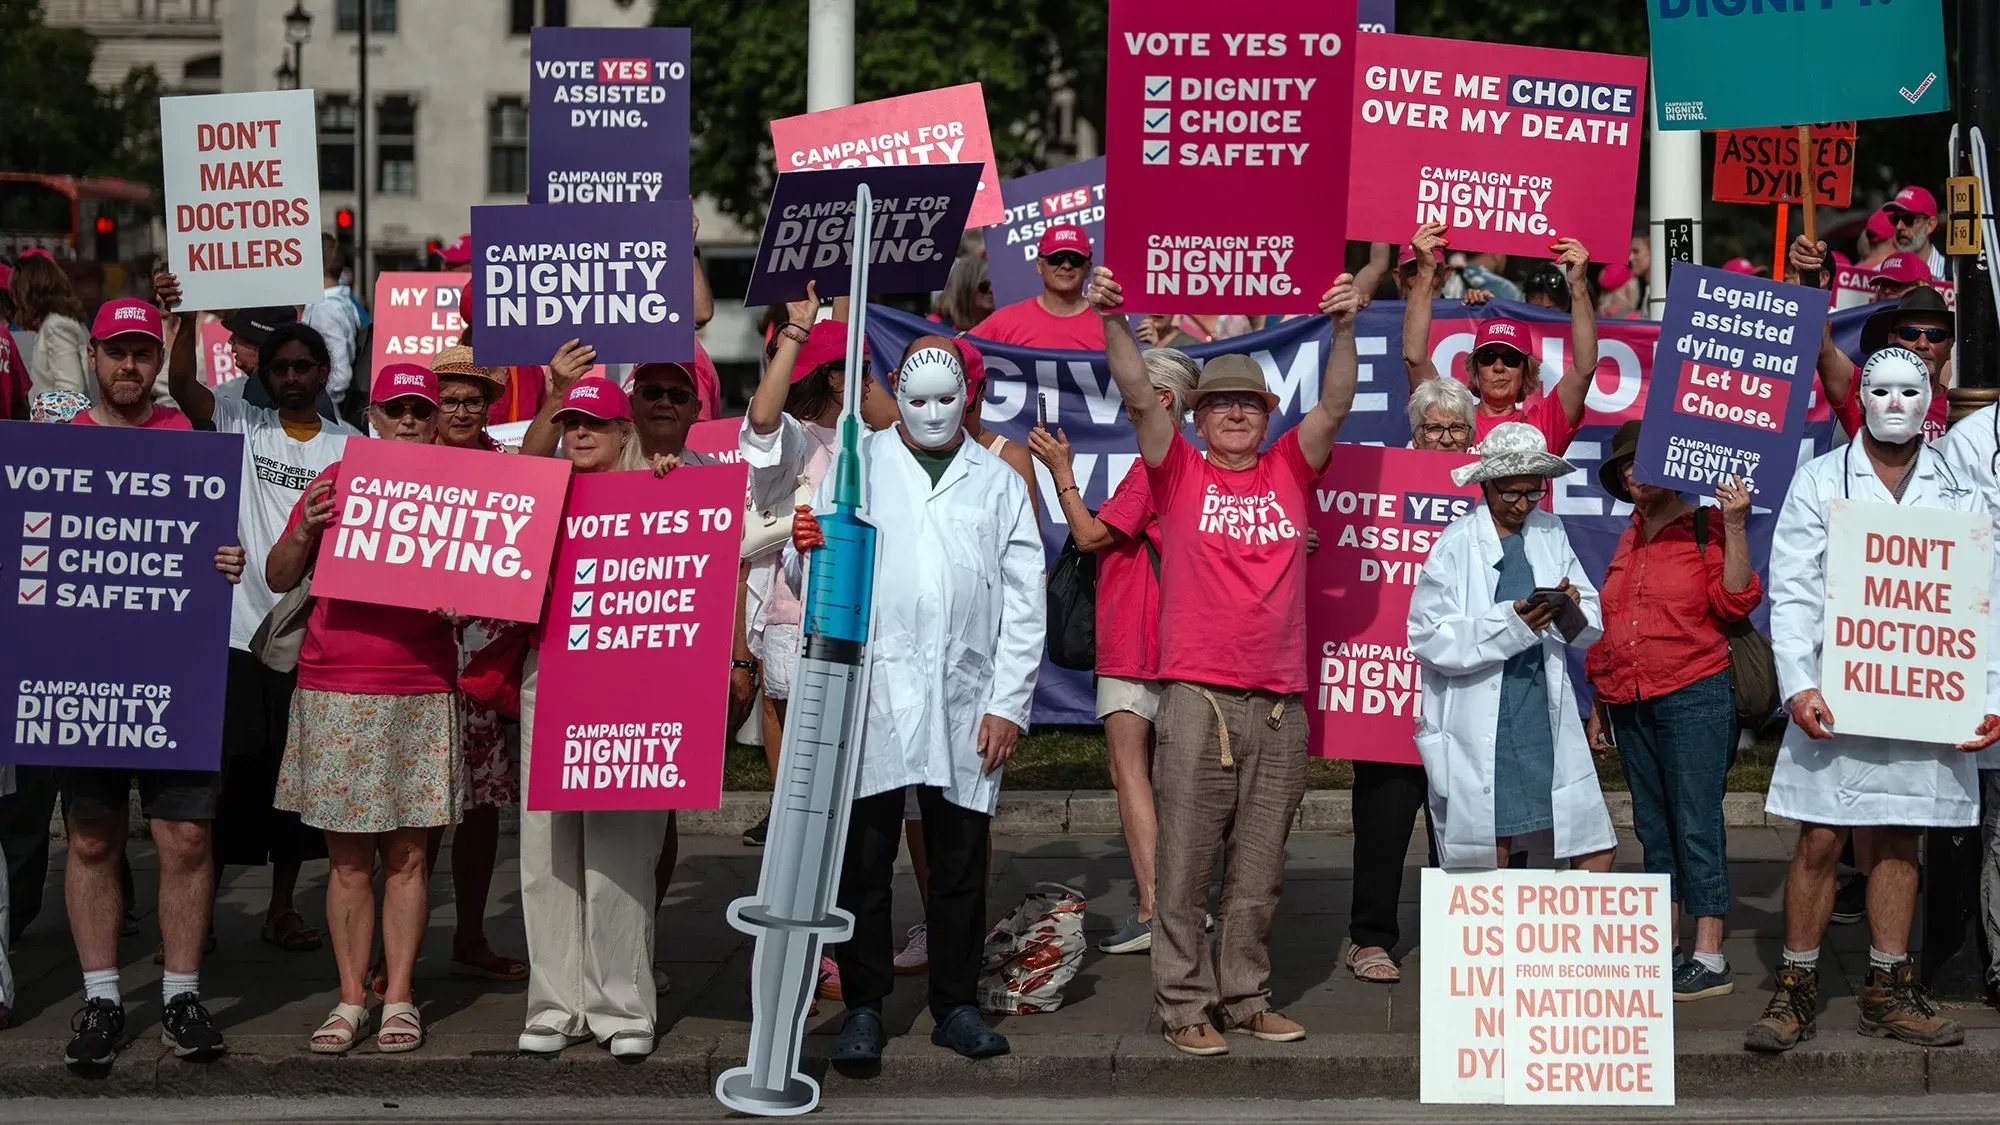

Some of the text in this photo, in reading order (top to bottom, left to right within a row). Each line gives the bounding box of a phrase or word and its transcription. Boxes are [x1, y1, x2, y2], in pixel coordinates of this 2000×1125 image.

[1124, 32, 1341, 56] VOTE YES TO
[536, 61, 685, 79] VOTE YES TO
[554, 86, 666, 103] ASSISTED
[1180, 78, 1317, 100] DIGNITY
[1365, 66, 1632, 112] GIVE ME CHOICE
[571, 110, 648, 127] DYING.
[1180, 110, 1302, 132] CHOICE
[1362, 100, 1628, 146] OVER MY DEATH
[197, 120, 281, 152] DON'T
[791, 121, 964, 167] CAMPAIGN FOR
[1722, 134, 1852, 167] ASSISED
[1179, 143, 1310, 166] SAFETY
[200, 160, 283, 191] MAKE
[548, 171, 662, 184] CAMPAIGN FOR
[1420, 166, 1552, 190] CAMPAIGN FOR
[548, 184, 662, 203] DIGNITY
[783, 196, 950, 219] CAMPAGN FOR
[999, 201, 1040, 226] OTE
[1045, 189, 1087, 212] YES
[1418, 180, 1551, 212] DIGNITY
[177, 198, 309, 232] DOCTORS
[1416, 203, 1556, 236] IN DYING.
[188, 238, 302, 272] KILLERS
[486, 241, 667, 262] CAMPAIGN FOR
[1148, 234, 1294, 249] CAMPAIGN FOR
[767, 244, 809, 273] IN
[1146, 249, 1293, 272] DIGNITY
[486, 261, 667, 295] DIGNITY
[1146, 272, 1301, 296] IN DYING.
[391, 288, 428, 306] MY
[487, 297, 527, 326] IN
[537, 293, 680, 326] DYING.
[1698, 278, 1799, 317] Legalise
[1691, 310, 1794, 345] assisted
[386, 336, 458, 354] ASSIS
[1676, 334, 1798, 375] dying and
[1690, 365, 1772, 399] Let Us
[1682, 393, 1777, 429] Choose.
[1666, 445, 1759, 477] DIGNITY
[1670, 436, 1761, 463] CAMPAIGN FOR
[5, 466, 225, 499] VOTE YES TO
[280, 463, 306, 476] THERE
[307, 469, 316, 477] IS
[285, 477, 296, 488] IS
[1663, 461, 1686, 478] IN
[350, 476, 536, 512] CAMPAIGN FOR
[1317, 489, 1467, 522] VOTE YES
[60, 515, 200, 544] DIGNITY
[341, 495, 532, 545] DIGNITY
[566, 508, 732, 539] VOTE YES TO
[1199, 515, 1224, 534] IN
[1337, 524, 1441, 554] ASSIS
[1866, 533, 1955, 570] DON'T
[58, 549, 183, 577] CHOICE
[334, 528, 532, 580] IN DYING.
[602, 554, 710, 582] DIGNITY
[56, 583, 191, 612] SAFETY
[600, 589, 695, 615] CHOICE
[1864, 576, 1951, 614] MAKE
[596, 623, 700, 650] SAFETY
[1836, 616, 1976, 660] DOCTORS
[1322, 641, 1416, 662] CAMPAIG
[847, 671, 854, 682] 3
[1320, 657, 1422, 690] DIGNI
[1844, 661, 1965, 701] KILLERS
[19, 680, 171, 698] CAMPAIGN FOR
[1318, 685, 1354, 712] IN
[17, 696, 170, 723] DIGNITY
[15, 721, 176, 749] IN DYING.
[566, 723, 682, 739] CAMPAIGN FOR
[838, 740, 845, 751] 4
[564, 738, 681, 764] DIGNITY
[562, 764, 686, 789] IN DYING.
[828, 809, 834, 820] 5
[1518, 886, 1658, 916] PROTECT
[1516, 923, 1659, 954] OUR NHS
[1516, 964, 1660, 978] FROM BECOMING THE
[1516, 988, 1663, 1018] NATIONAL
[1529, 1025, 1649, 1055] SUICIDE
[1525, 1062, 1653, 1092] SERVICE
